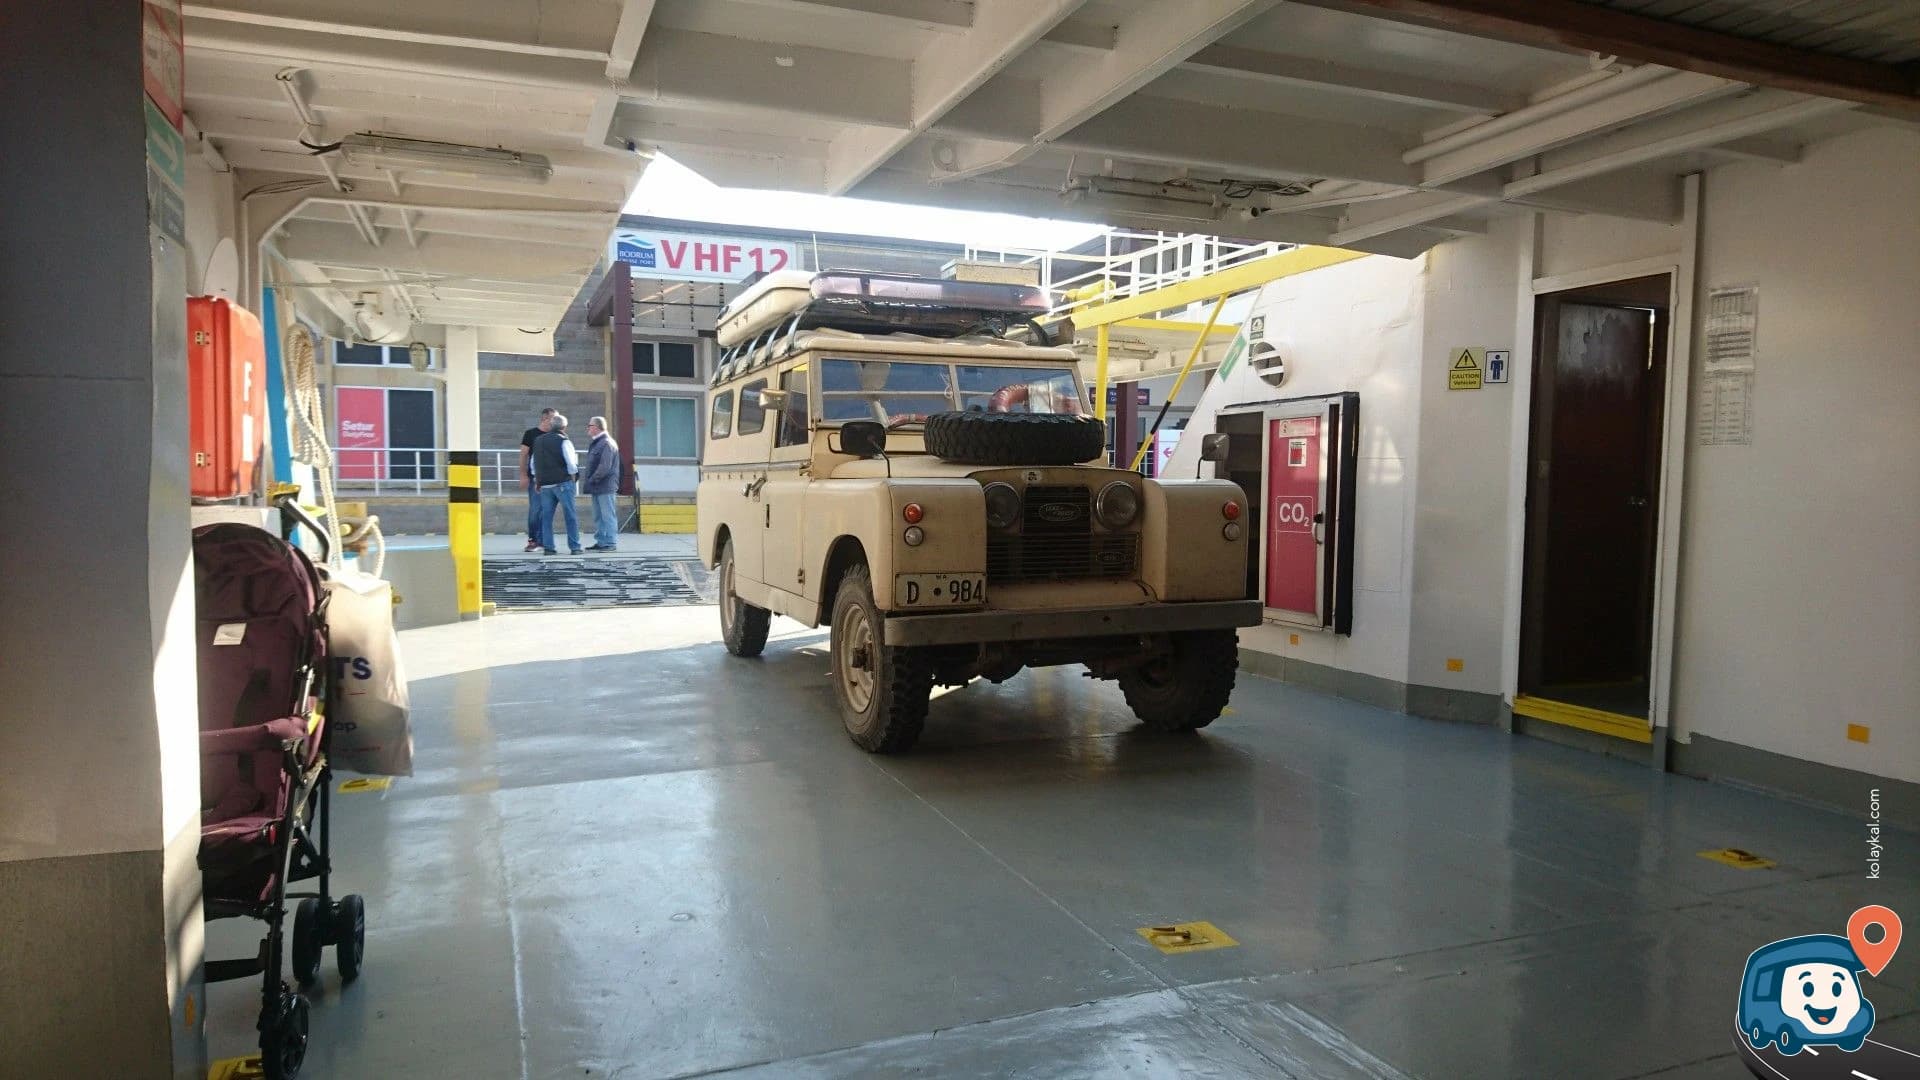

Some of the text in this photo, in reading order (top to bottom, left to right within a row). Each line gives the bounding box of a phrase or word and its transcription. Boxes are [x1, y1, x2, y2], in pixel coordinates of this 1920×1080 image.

[619, 250, 654, 260] BODRUM
[907, 579, 983, 604] D 984
